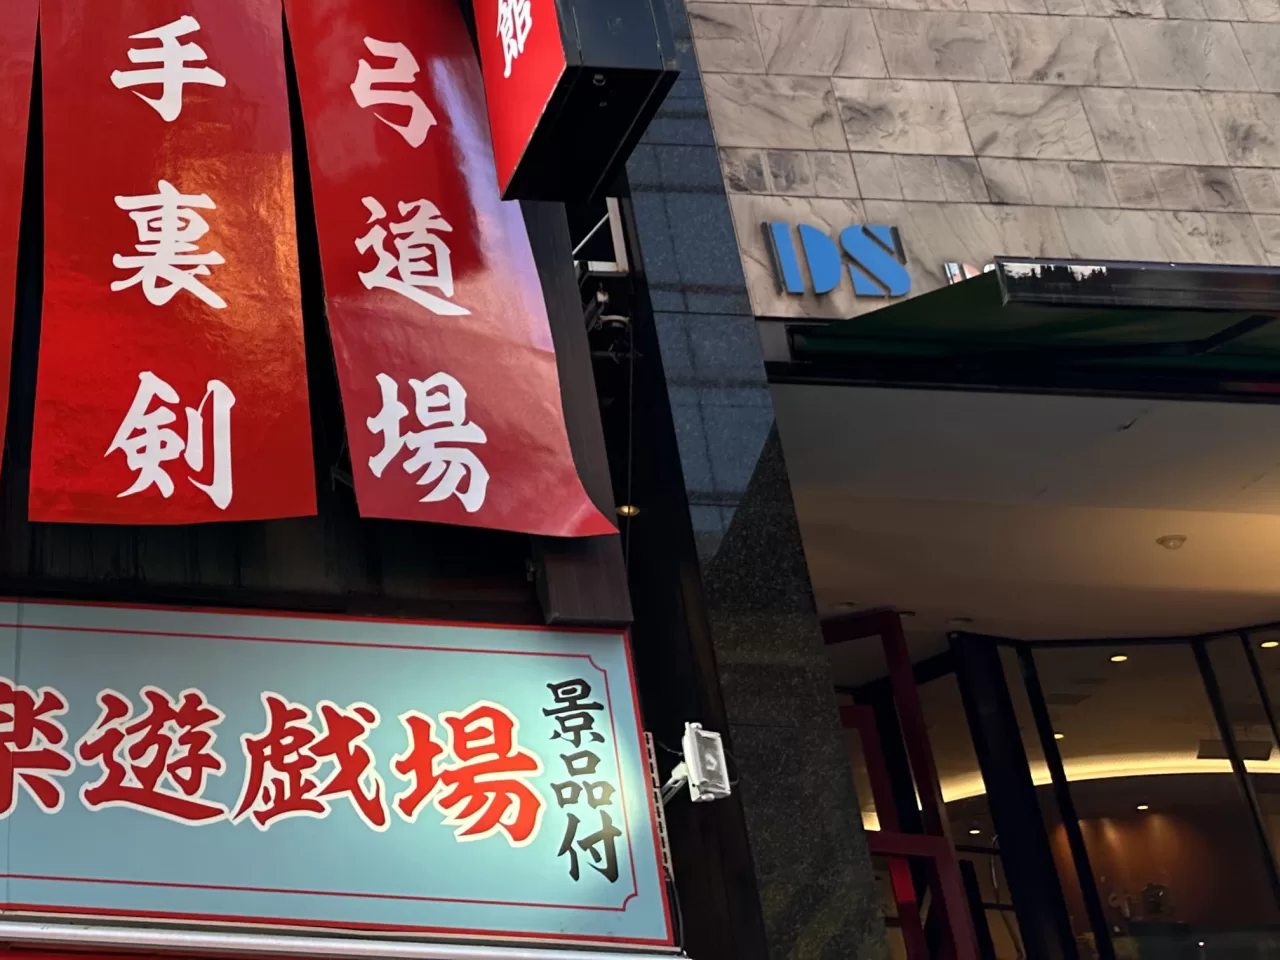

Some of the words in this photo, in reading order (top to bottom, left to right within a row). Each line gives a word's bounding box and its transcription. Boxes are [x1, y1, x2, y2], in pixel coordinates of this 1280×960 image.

[104, 14, 236, 511] 手裏剣
[349, 35, 490, 513] 弓道場
[761, 221, 912, 298] DS
[542, 677, 623, 884] 景品付
